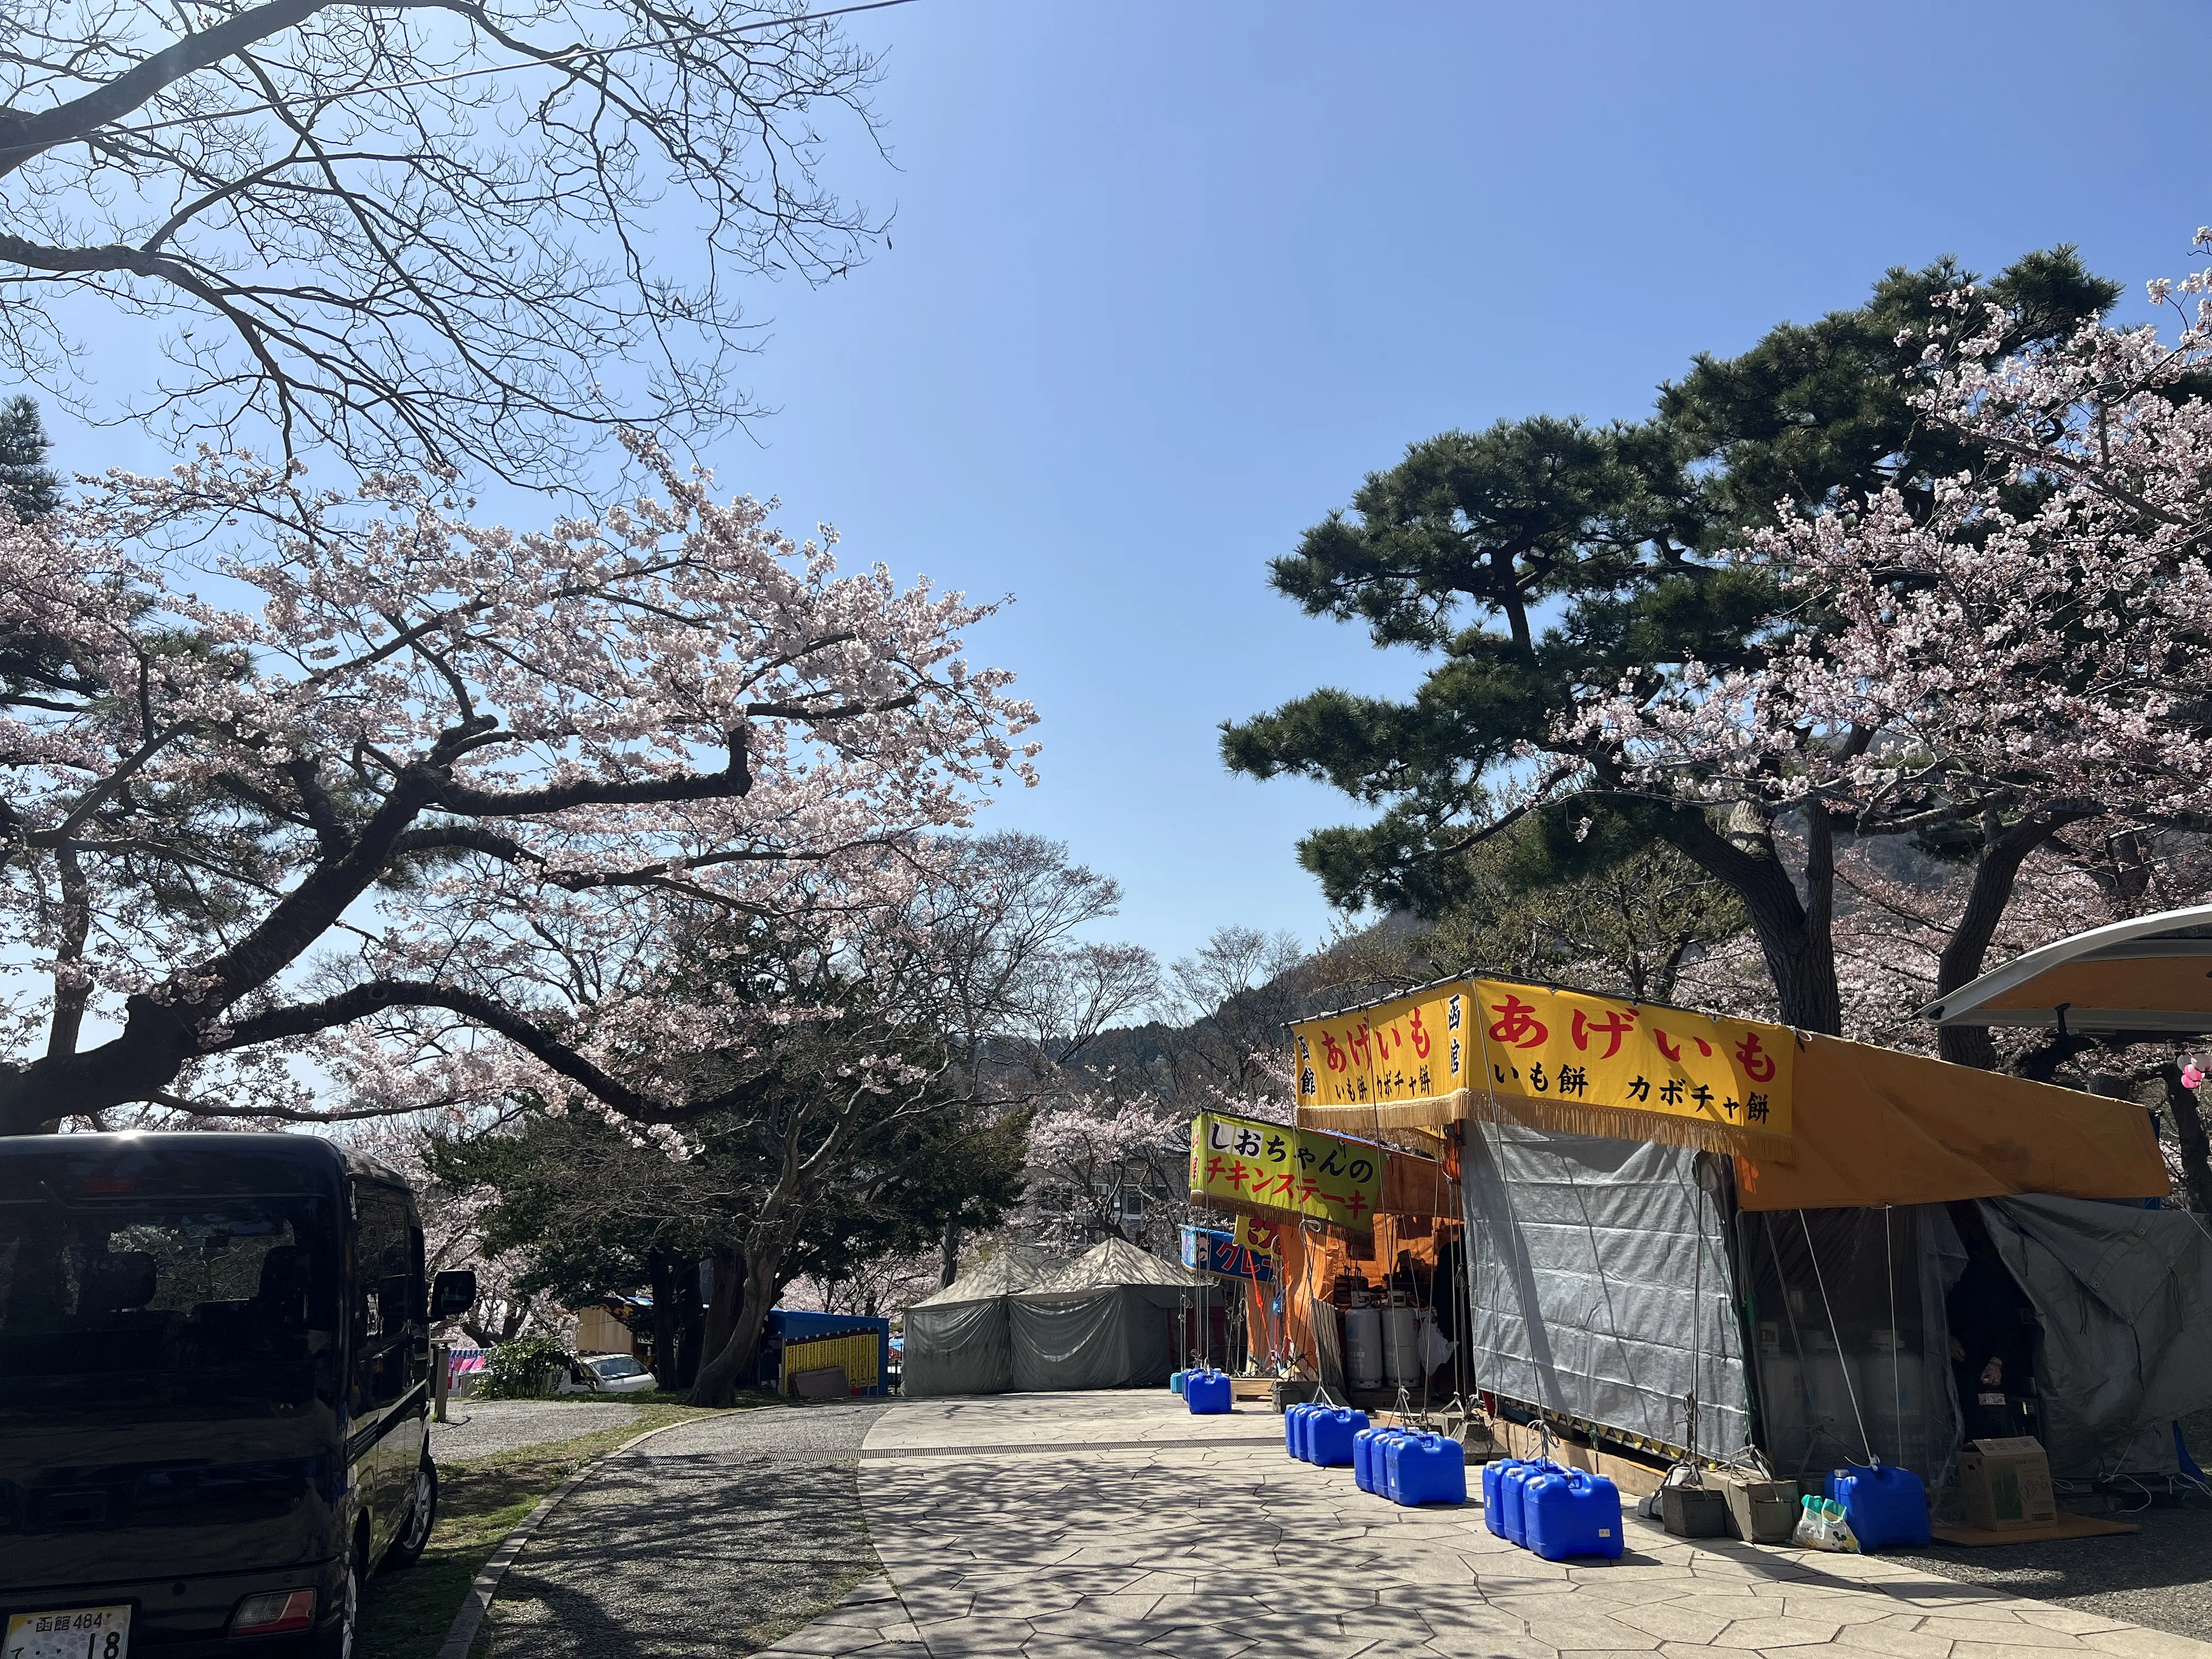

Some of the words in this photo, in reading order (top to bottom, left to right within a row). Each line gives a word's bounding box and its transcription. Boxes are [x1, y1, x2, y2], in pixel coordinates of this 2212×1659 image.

[1322, 1007, 1430, 1073] あげいも
[1489, 994, 1776, 1082] あげいも
[1495, 1062, 1589, 1097] いも餅
[1626, 1076, 1770, 1125] カボチャ餅
[1211, 1123, 1373, 1183] しおちゃんの
[1204, 1156, 1369, 1220] チキンステーキ
